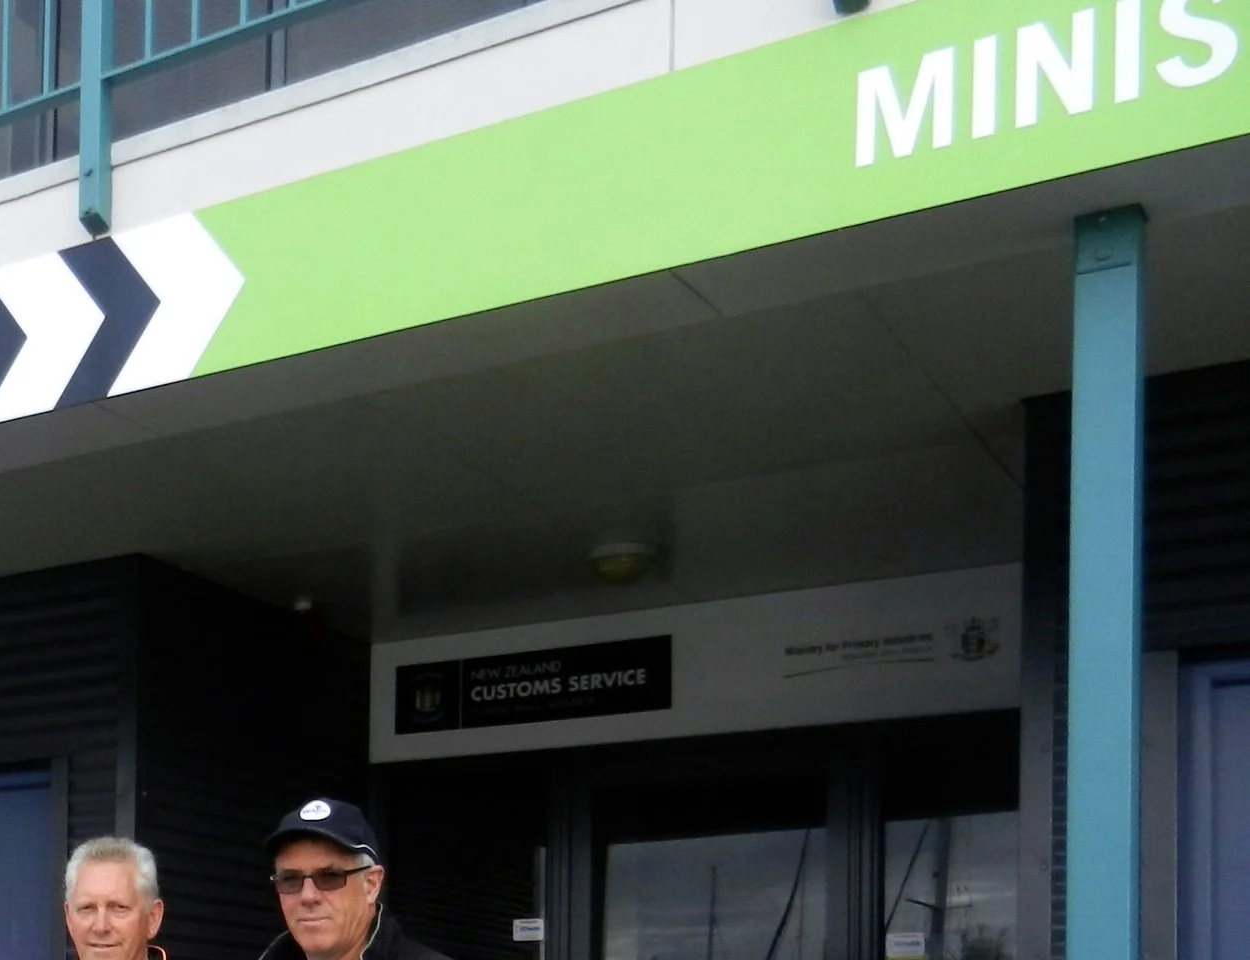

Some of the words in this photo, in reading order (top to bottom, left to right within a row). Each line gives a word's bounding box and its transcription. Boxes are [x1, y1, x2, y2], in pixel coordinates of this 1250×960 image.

[855, 0, 1239, 168] MINIS
[470, 667, 500, 681] NEW
[504, 660, 562, 677] ZEALAND
[470, 678, 562, 702] CUSTOMS
[568, 668, 647, 692] SERVICE
